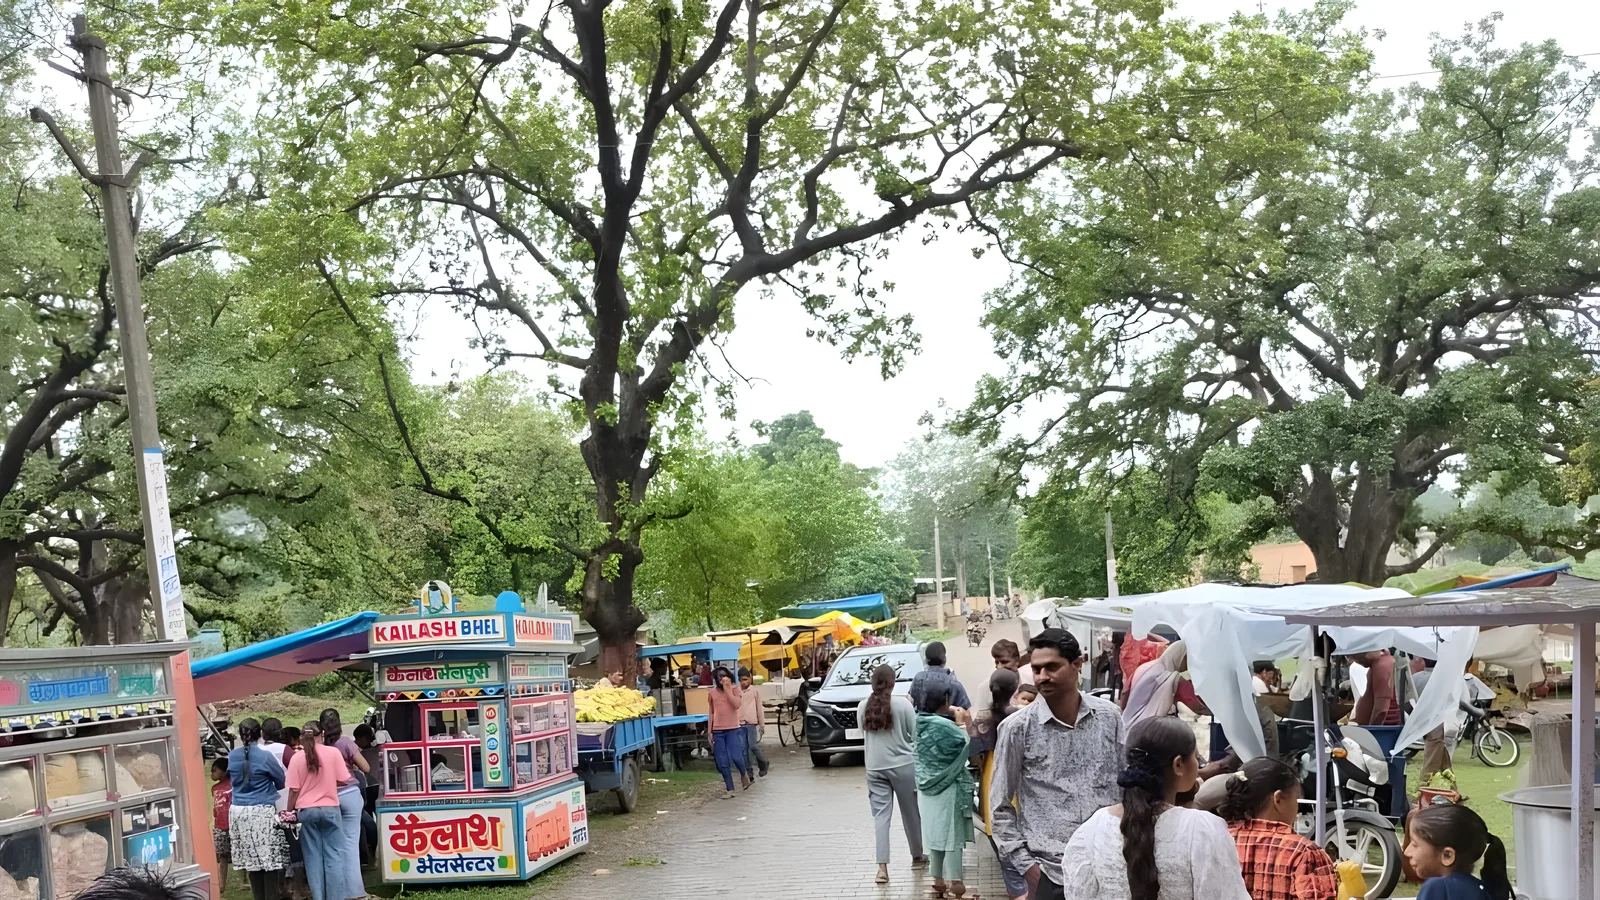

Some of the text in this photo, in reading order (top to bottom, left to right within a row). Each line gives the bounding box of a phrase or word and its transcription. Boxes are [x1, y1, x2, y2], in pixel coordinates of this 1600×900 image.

[375, 618, 500, 642] KAILASH BHEL
[388, 812, 503, 856] कैलाश
